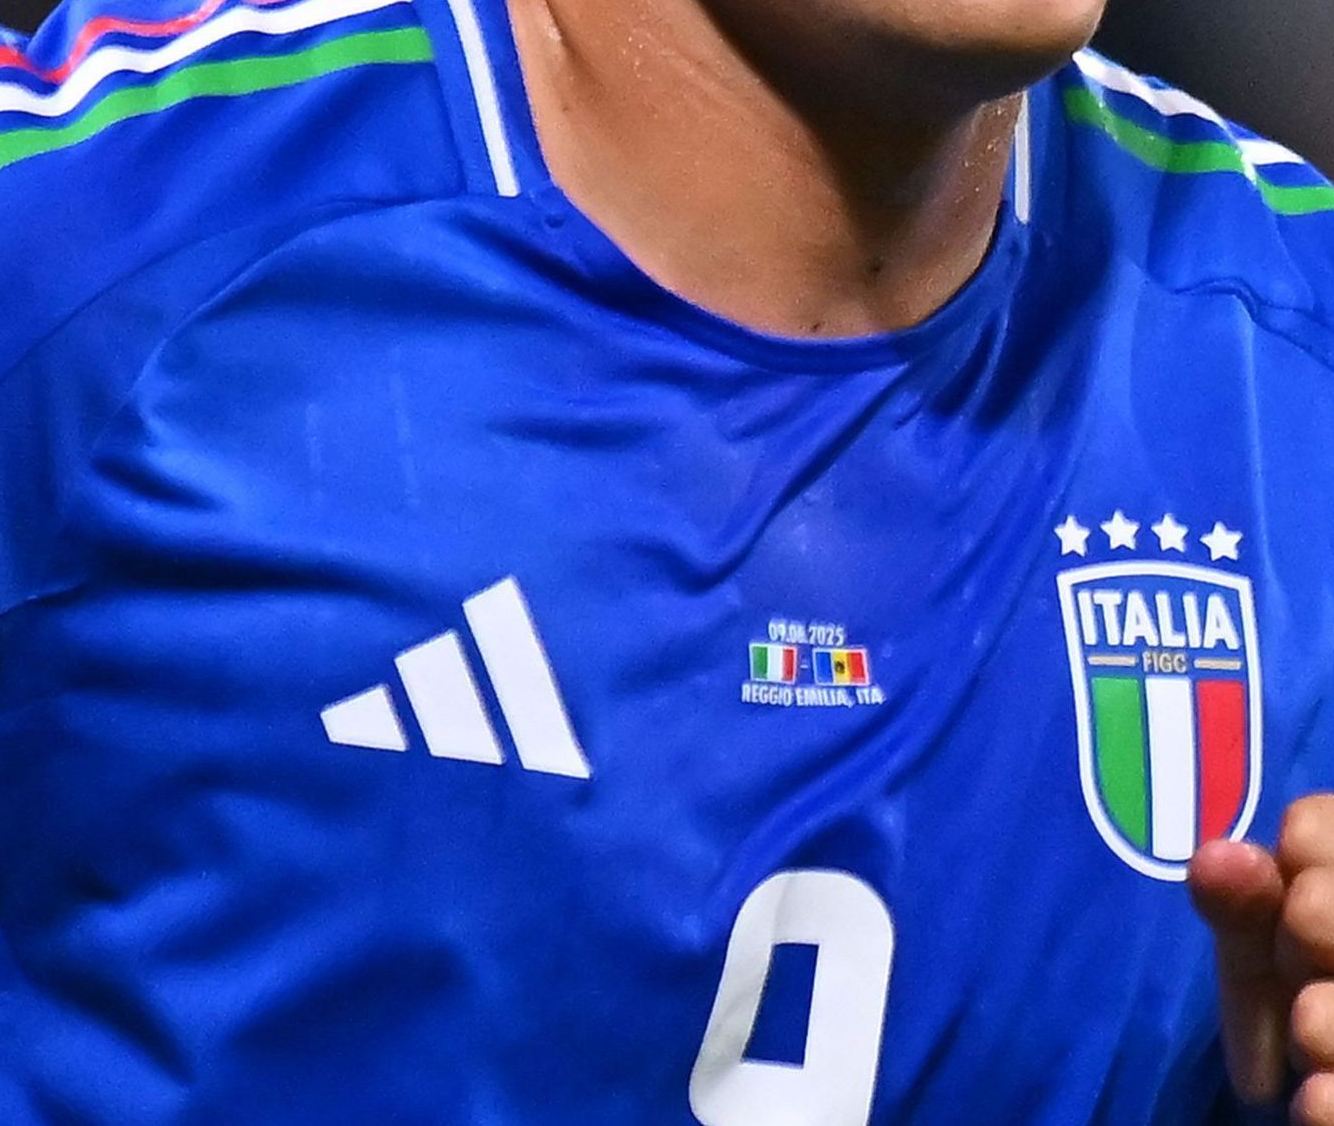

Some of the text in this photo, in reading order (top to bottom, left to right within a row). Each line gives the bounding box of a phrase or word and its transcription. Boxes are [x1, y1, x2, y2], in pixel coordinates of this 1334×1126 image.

[1077, 589, 1241, 650] ITALIA
[1142, 651, 1186, 673] FIGC
[742, 683, 885, 708] REGGIO EMILIA, ITA
[689, 870, 894, 1126] 9
